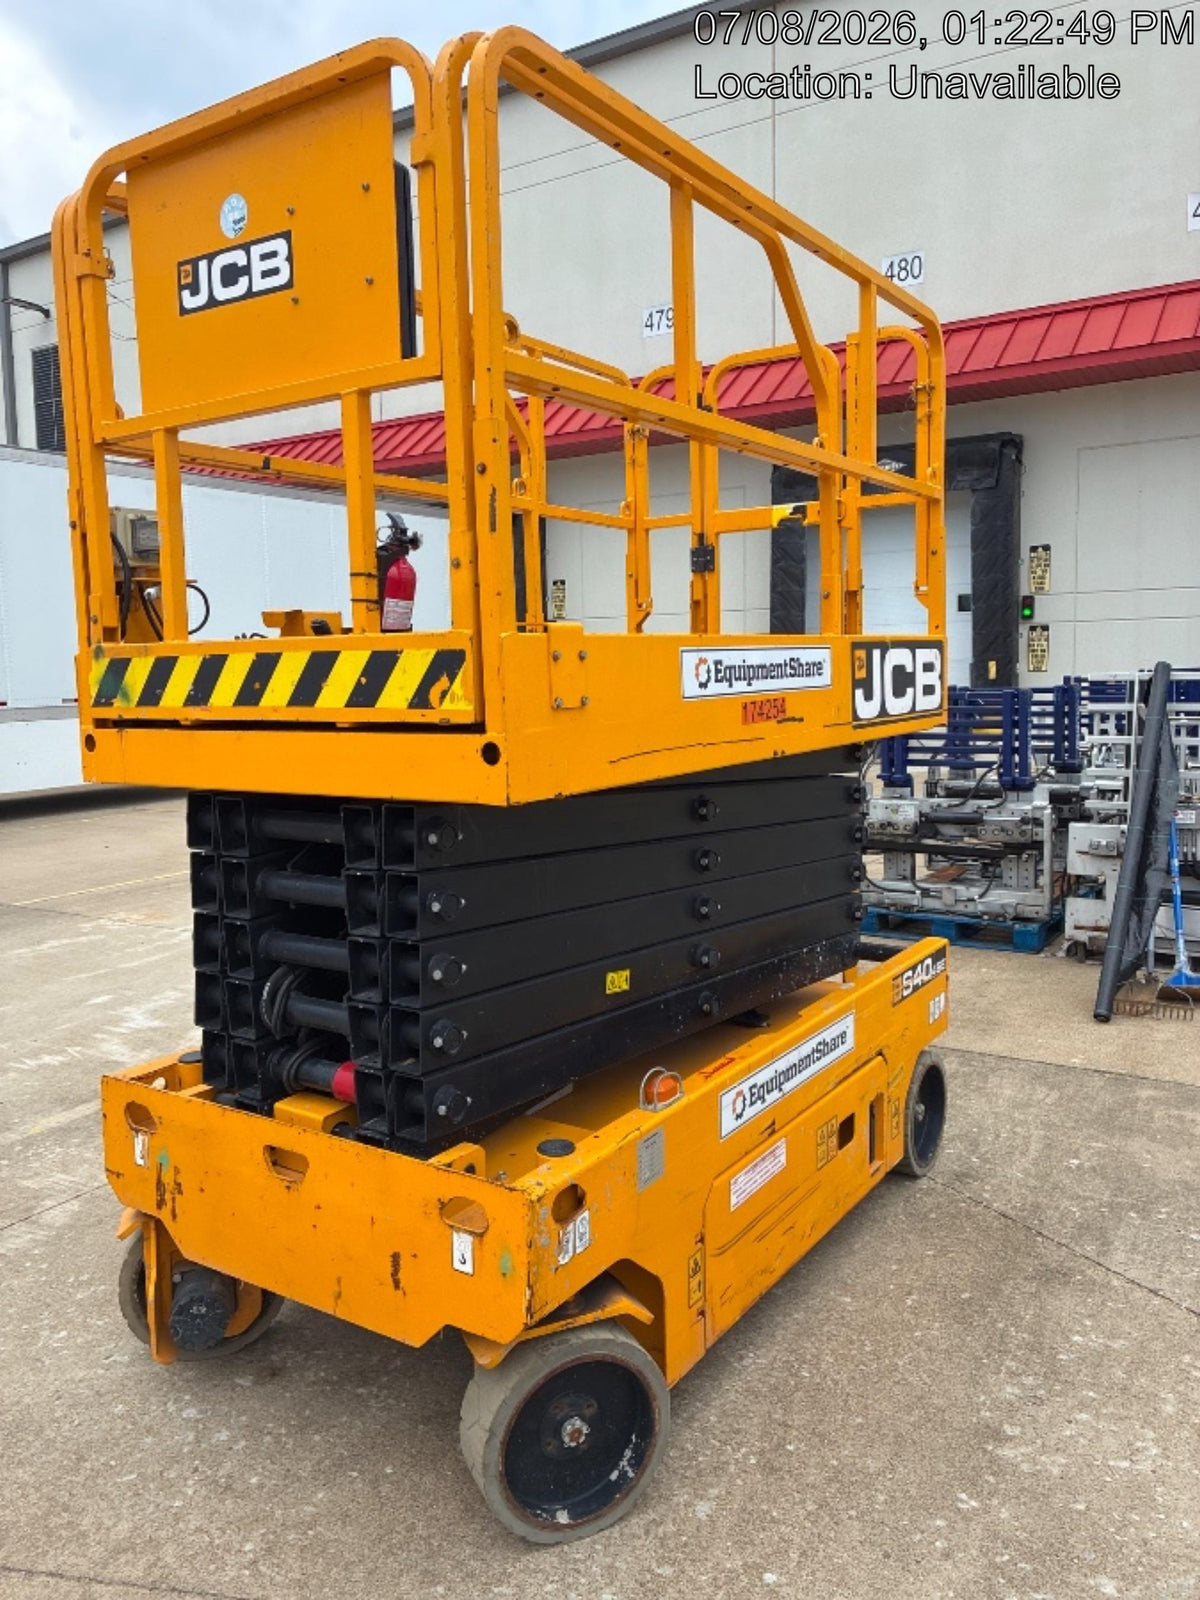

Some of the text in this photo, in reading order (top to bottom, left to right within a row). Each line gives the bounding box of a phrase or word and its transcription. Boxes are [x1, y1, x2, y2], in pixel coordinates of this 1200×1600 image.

[181, 238, 290, 309] JCB
[885, 255, 922, 281] 480
[645, 307, 674, 331] 479
[713, 657, 824, 688] EquipmentShare
[854, 648, 942, 719] JCB
[742, 698, 786, 724] 174254
[748, 1030, 848, 1108] EquipmentShare
